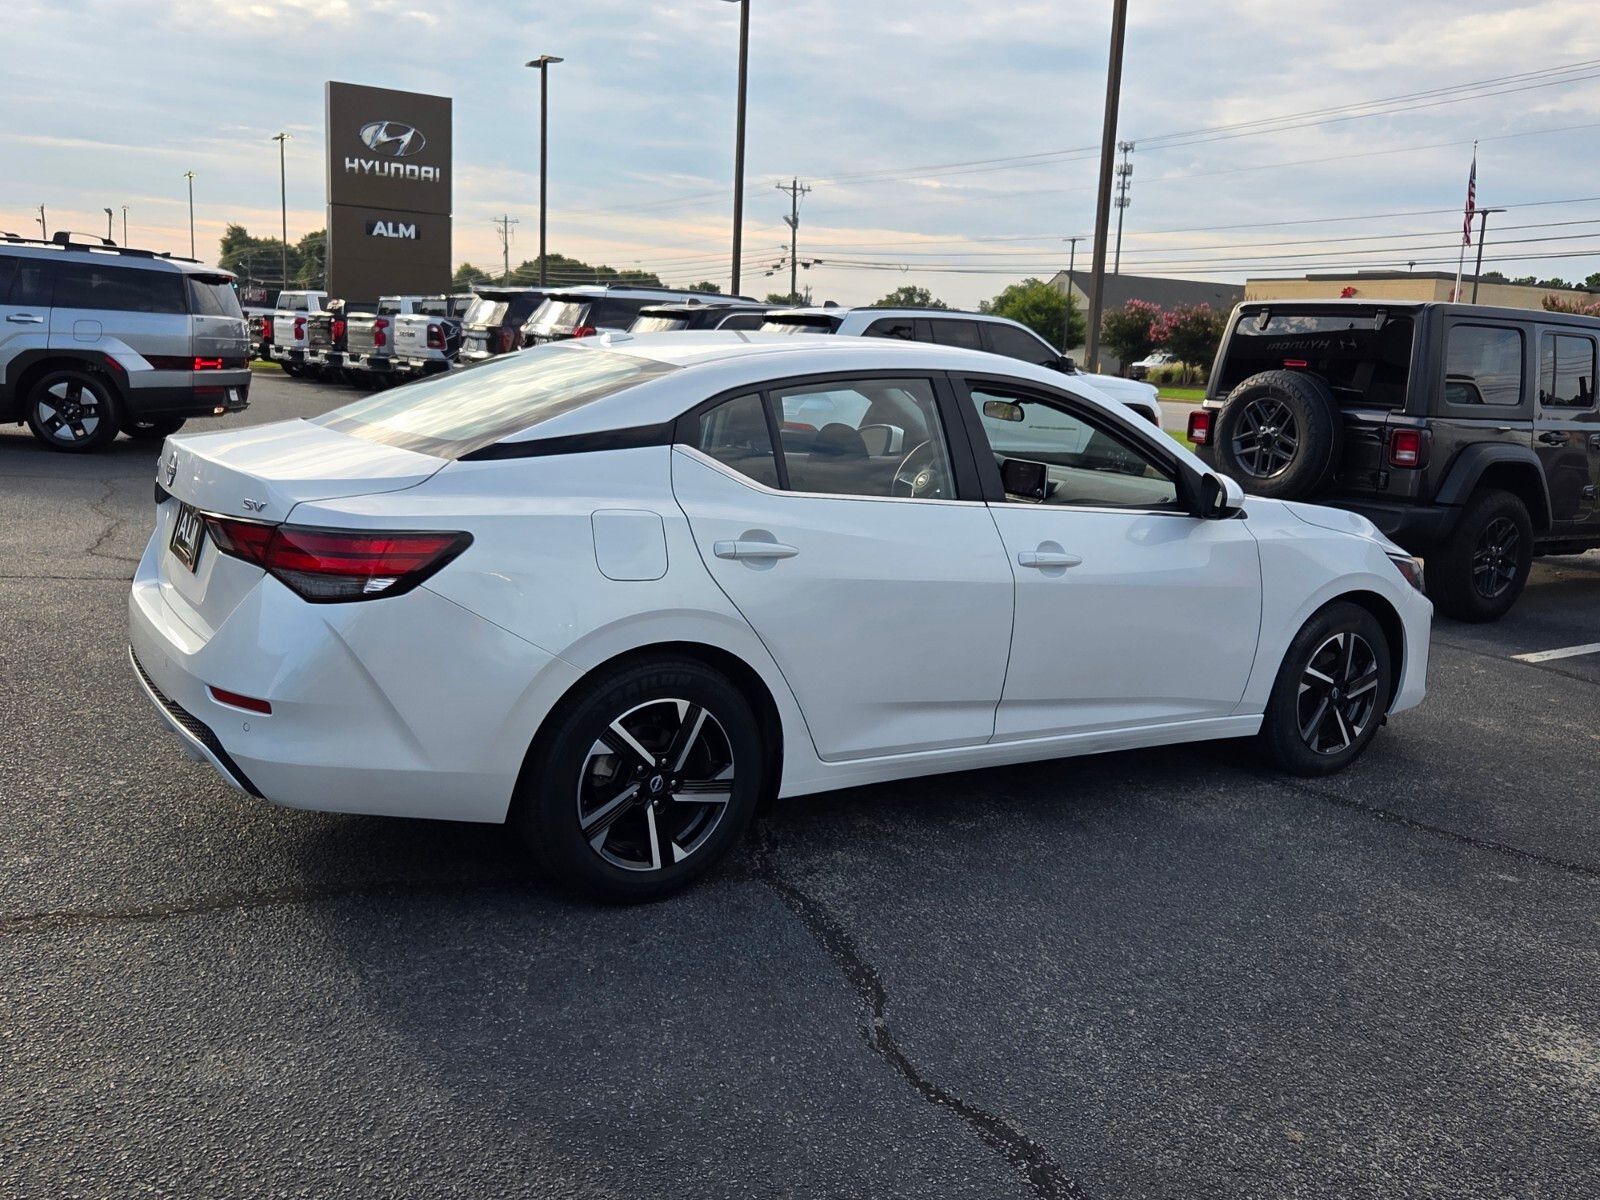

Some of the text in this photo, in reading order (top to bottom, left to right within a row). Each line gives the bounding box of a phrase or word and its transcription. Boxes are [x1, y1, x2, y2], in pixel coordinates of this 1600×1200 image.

[345, 157, 440, 182] HYUNDAI
[372, 221, 416, 239] ALM
[243, 498, 267, 512] SV
